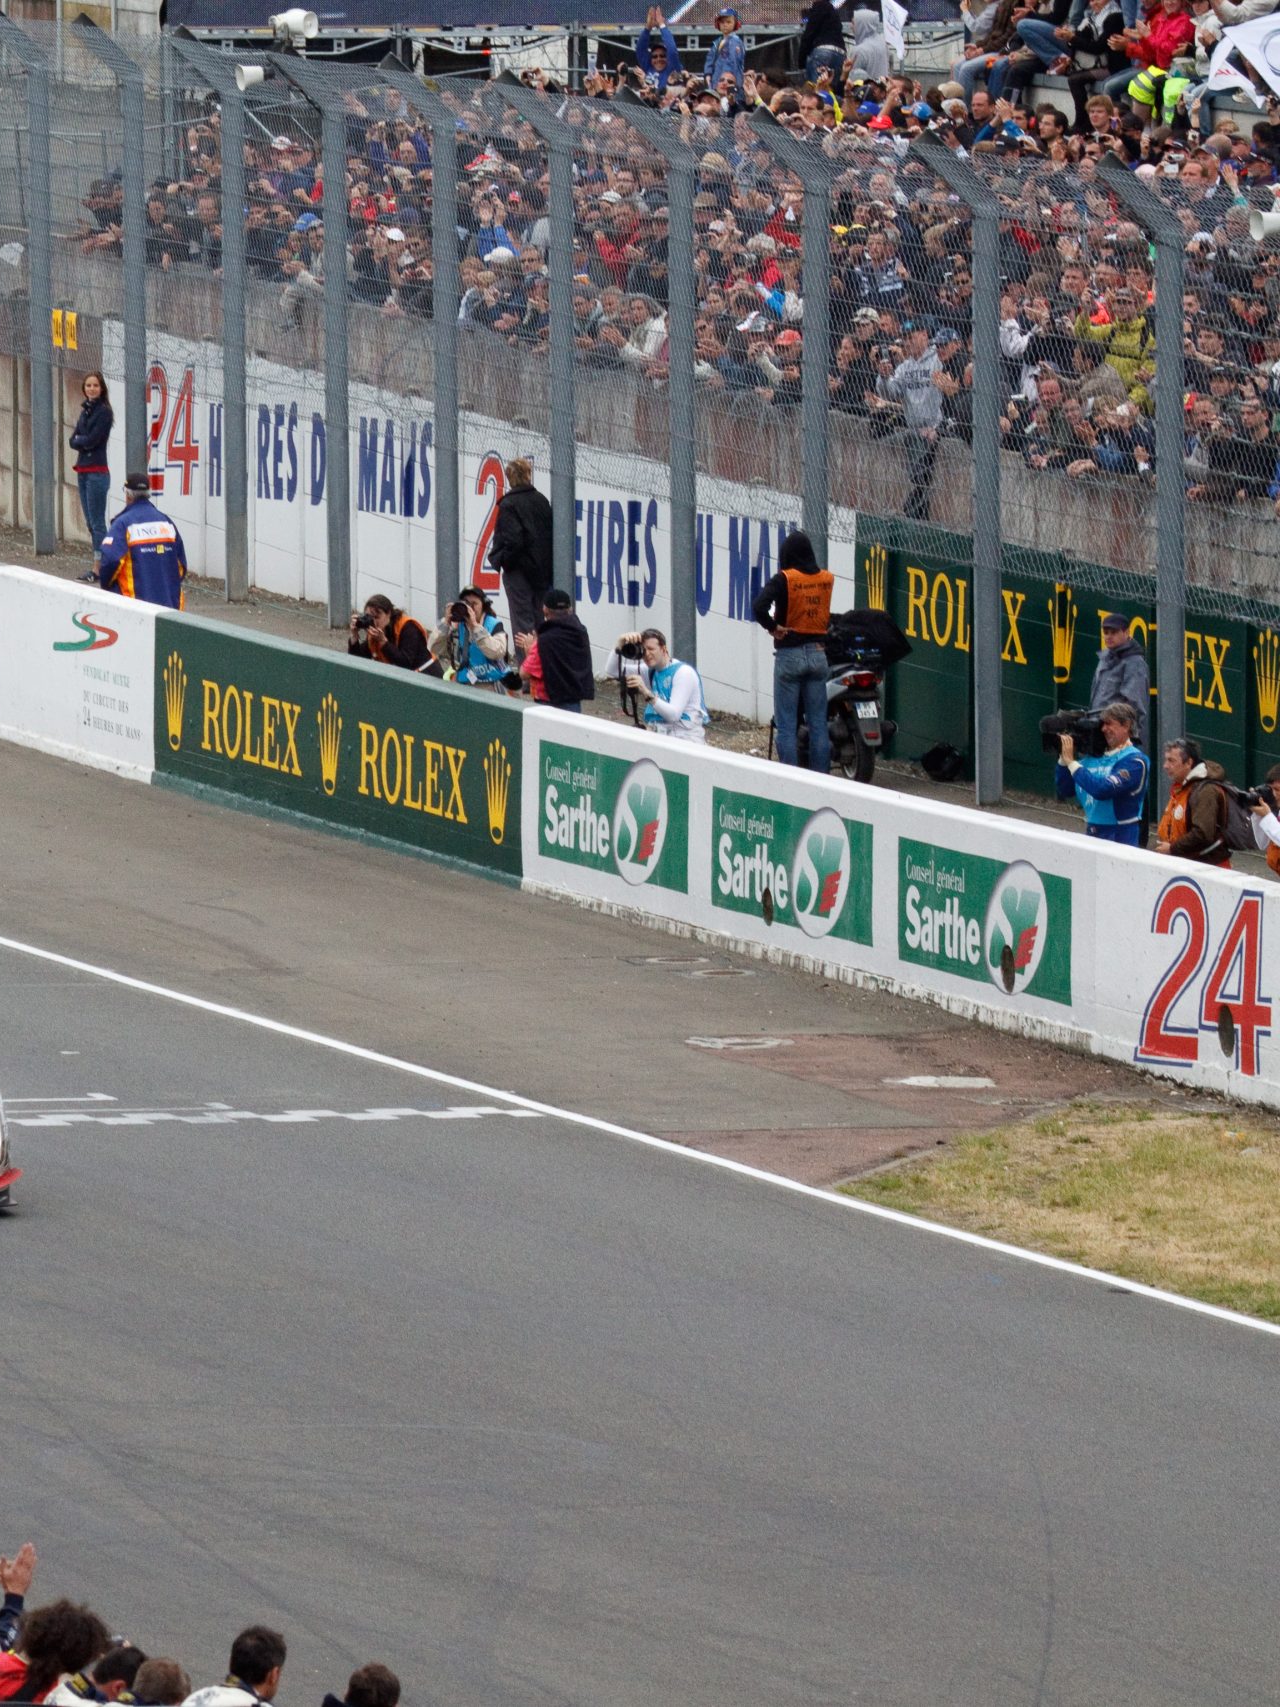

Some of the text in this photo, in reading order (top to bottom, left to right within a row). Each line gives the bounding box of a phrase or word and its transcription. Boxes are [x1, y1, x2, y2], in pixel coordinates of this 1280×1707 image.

[145, 360, 433, 519] 24 HRES D MANS
[575, 498, 658, 609] EURES
[696, 513, 713, 617] U
[905, 566, 1027, 665] ROLX
[201, 679, 303, 777] ROLEX
[358, 721, 468, 825] ROLEX
[545, 755, 597, 793] Conseil général
[544, 783, 610, 858] Sarthe
[719, 804, 774, 841] Conseil général
[718, 833, 789, 909] Sarthe
[905, 854, 965, 894] Conseil général
[905, 884, 981, 966] Sarthe
[1133, 875, 1273, 1077] 24
